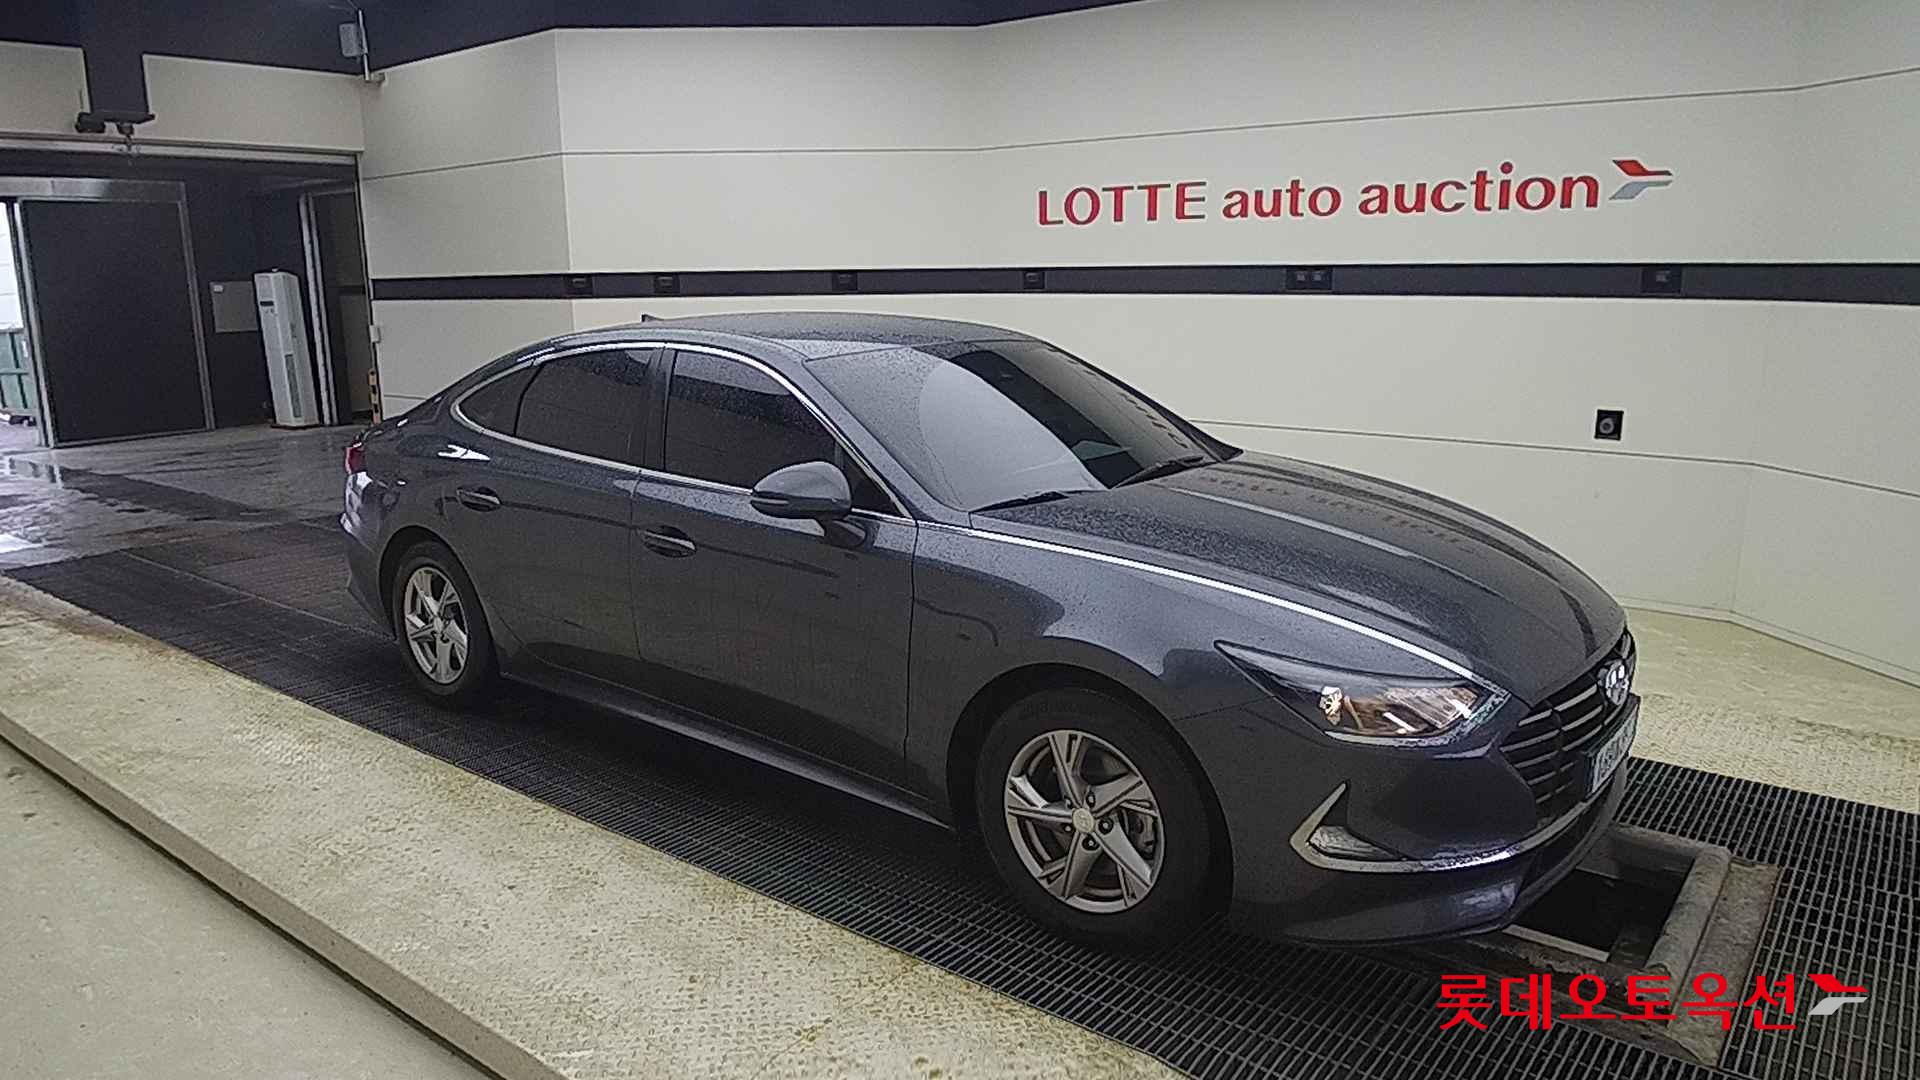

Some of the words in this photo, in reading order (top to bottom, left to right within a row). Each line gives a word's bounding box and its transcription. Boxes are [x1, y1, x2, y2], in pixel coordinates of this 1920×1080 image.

[1038, 181, 1207, 226] LOTTE
[1222, 179, 1342, 218] auto
[1358, 162, 1599, 214] auction
